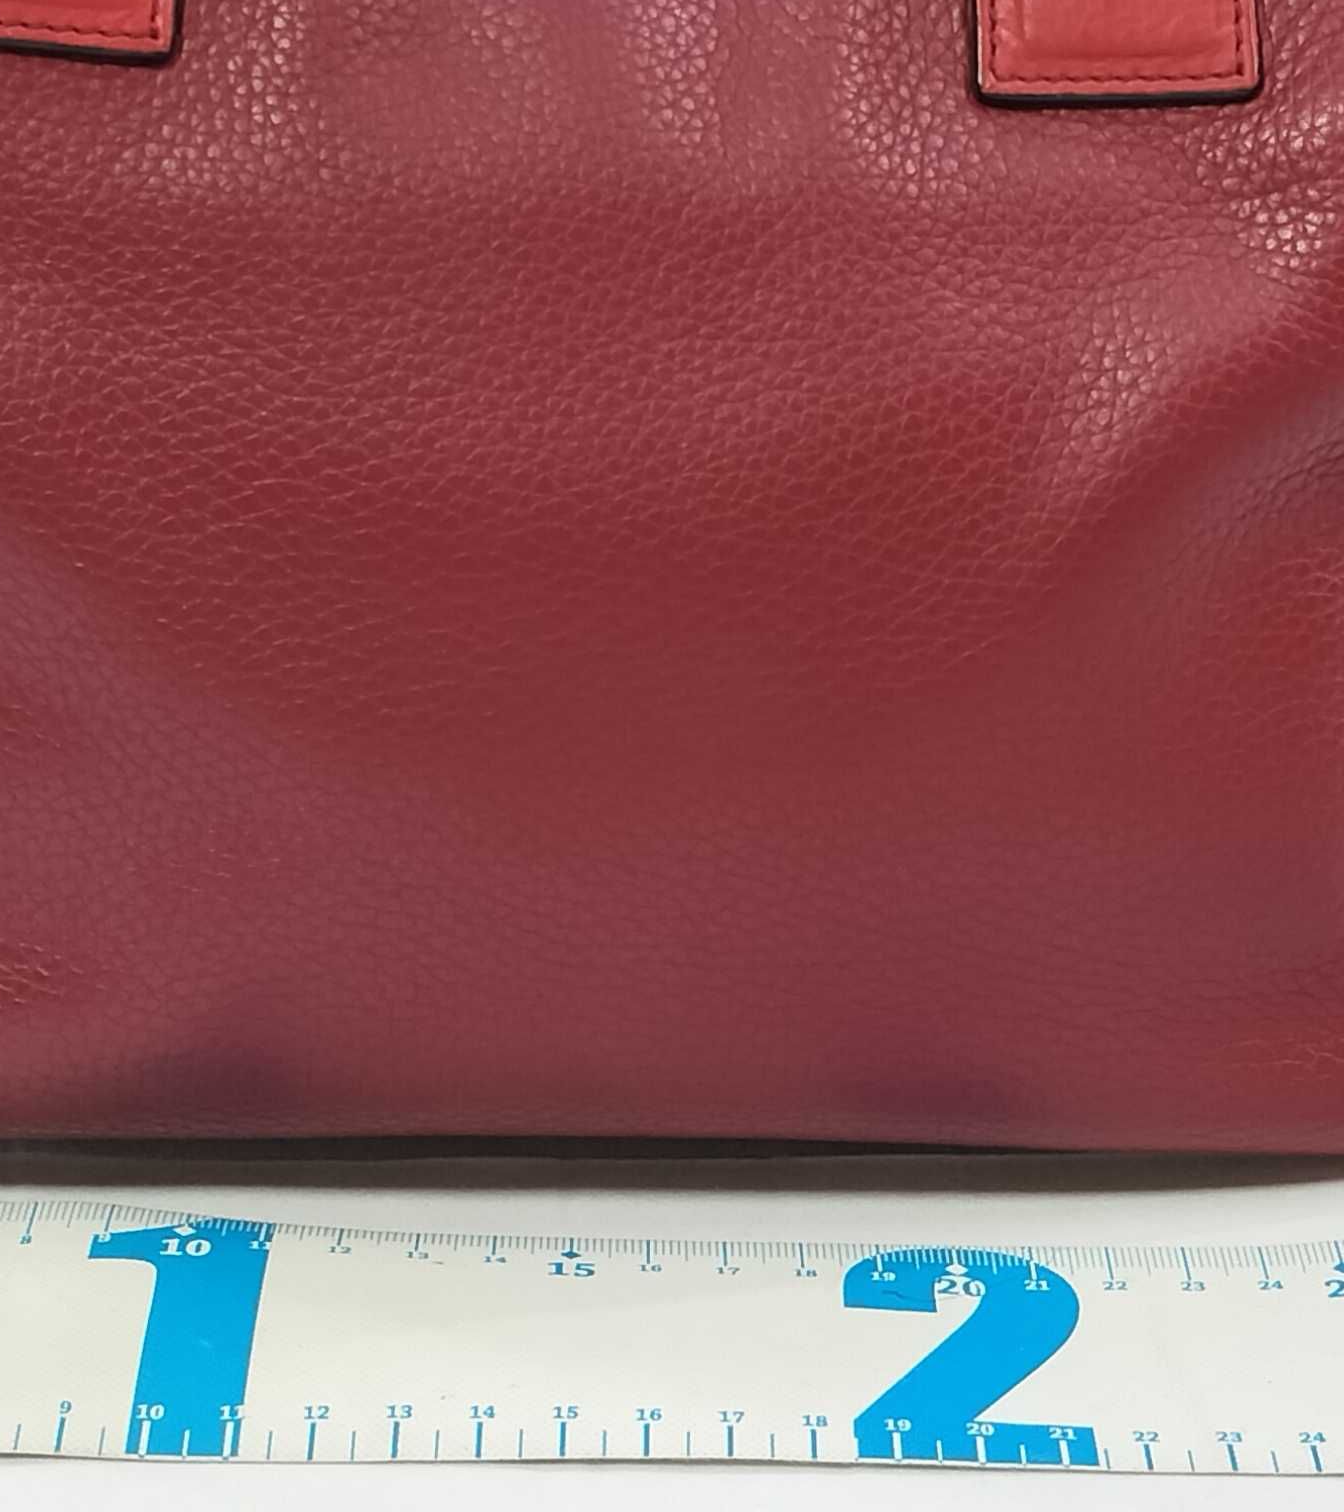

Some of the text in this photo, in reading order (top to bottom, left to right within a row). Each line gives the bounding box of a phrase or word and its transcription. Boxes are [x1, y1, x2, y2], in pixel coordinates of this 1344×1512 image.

[19, 1235, 33, 1245] 8
[159, 1238, 212, 1256] 10
[328, 1246, 352, 1254] 12
[484, 1255, 507, 1263] 14
[547, 1262, 595, 1278] 15
[640, 1264, 662, 1272] 16
[717, 1267, 740, 1275] 17
[871, 1271, 895, 1282] 19
[935, 1277, 986, 1297] 20
[1024, 1280, 1050, 1291] 21
[1102, 1281, 1128, 1291] 22
[1181, 1281, 1205, 1291] 23
[1257, 1280, 1283, 1290] 24
[88, 1219, 276, 1456] 1
[843, 1247, 1100, 1466] 2
[59, 1401, 72, 1414] 9
[135, 1404, 165, 1420] 10
[219, 1404, 245, 1419] 11
[304, 1405, 330, 1419] 12
[386, 1405, 413, 1419] 13
[469, 1405, 496, 1419] 14
[552, 1406, 579, 1419] 15
[635, 1408, 663, 1421] 16
[718, 1411, 745, 1423] 17
[801, 1414, 828, 1427] 18
[884, 1418, 912, 1432] 19
[966, 1423, 995, 1437] 20
[1048, 1427, 1077, 1440] 21
[1132, 1431, 1160, 1443] 22
[1216, 1431, 1243, 1443] 23
[1299, 1431, 1326, 1443] 24
